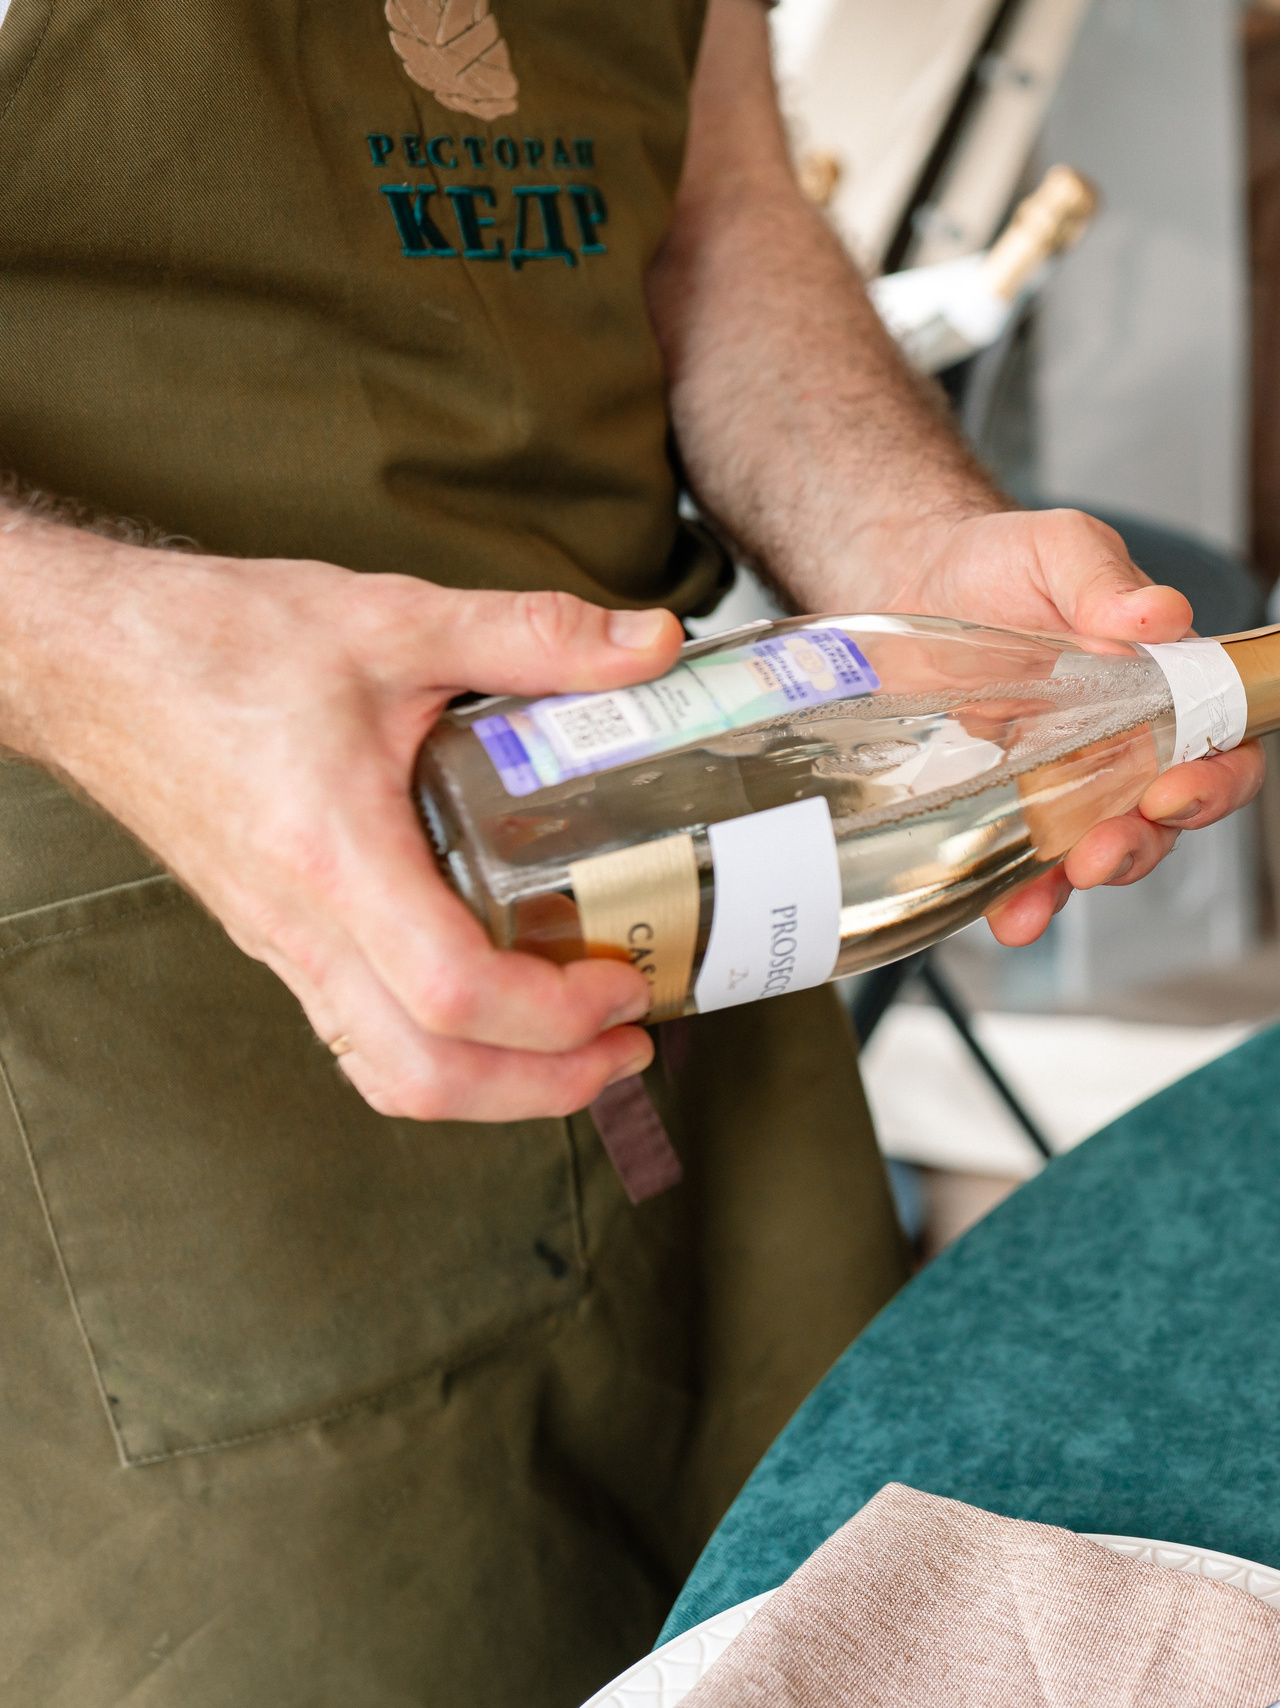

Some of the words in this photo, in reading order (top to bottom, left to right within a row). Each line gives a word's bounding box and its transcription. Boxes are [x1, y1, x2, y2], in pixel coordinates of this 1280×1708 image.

[366, 133, 595, 171] РЕСТОРАН
[379, 183, 608, 272] КЕДР
[627, 922, 657, 986] CAS
[760, 904, 798, 997] PROSECC
